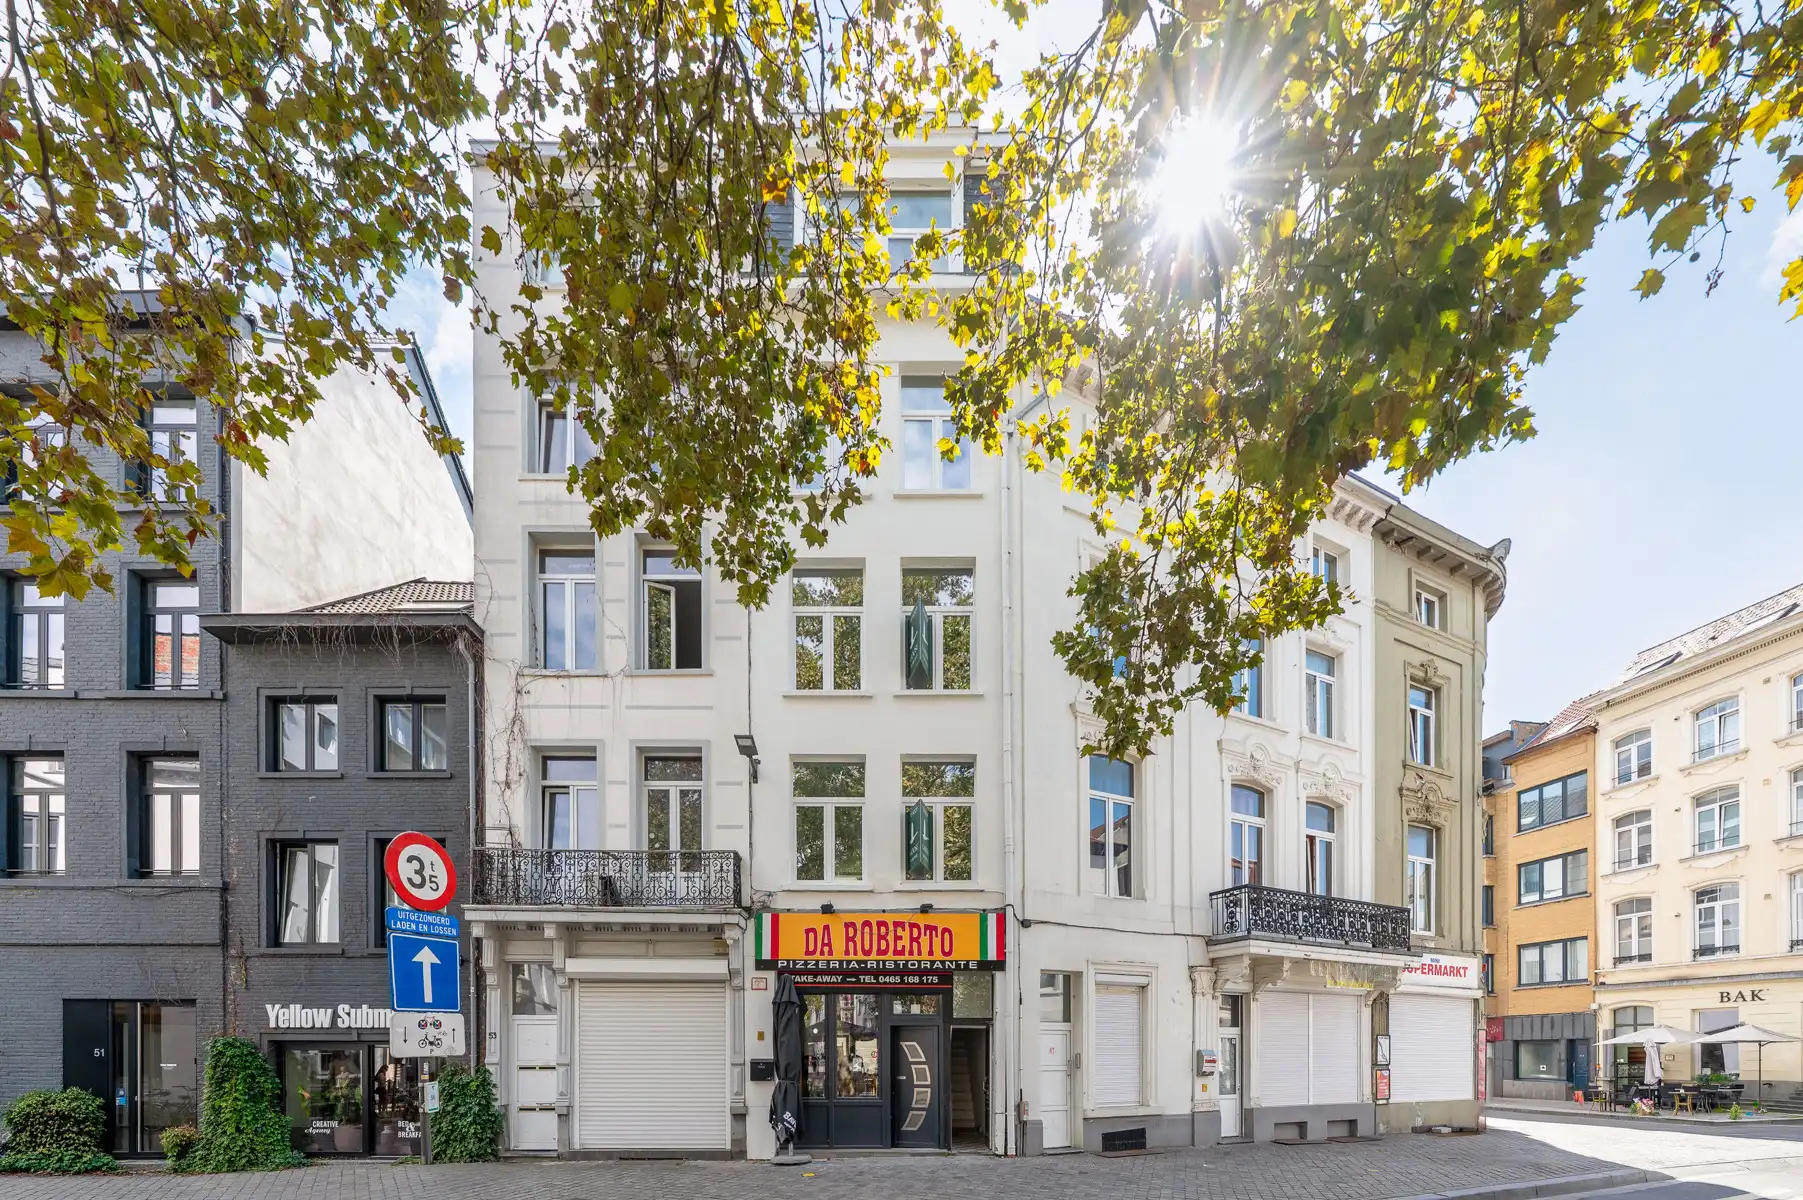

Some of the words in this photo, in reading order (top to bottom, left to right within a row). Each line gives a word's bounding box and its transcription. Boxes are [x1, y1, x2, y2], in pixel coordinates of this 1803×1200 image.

[406, 855, 426, 889] 3
[398, 911, 450, 925] UITGEZONDERD
[391, 920, 416, 931] LADEN
[419, 924, 428, 932] EN
[430, 926, 457, 936] LOSSEN
[804, 923, 834, 957] DA
[843, 919, 954, 957] ROBERTO
[777, 960, 978, 969] PIZZERIA-RISTORANTE
[859, 975, 876, 983] TEL
[878, 975, 900, 983] 0465
[903, 975, 919, 983] 168
[922, 975, 938, 983] 175
[1719, 989, 1766, 1003] BAK
[265, 1004, 335, 1029] Yellow
[337, 1004, 394, 1029] Subm
[94, 1048, 105, 1057] 51
[397, 1131, 422, 1139] BREAKFA
